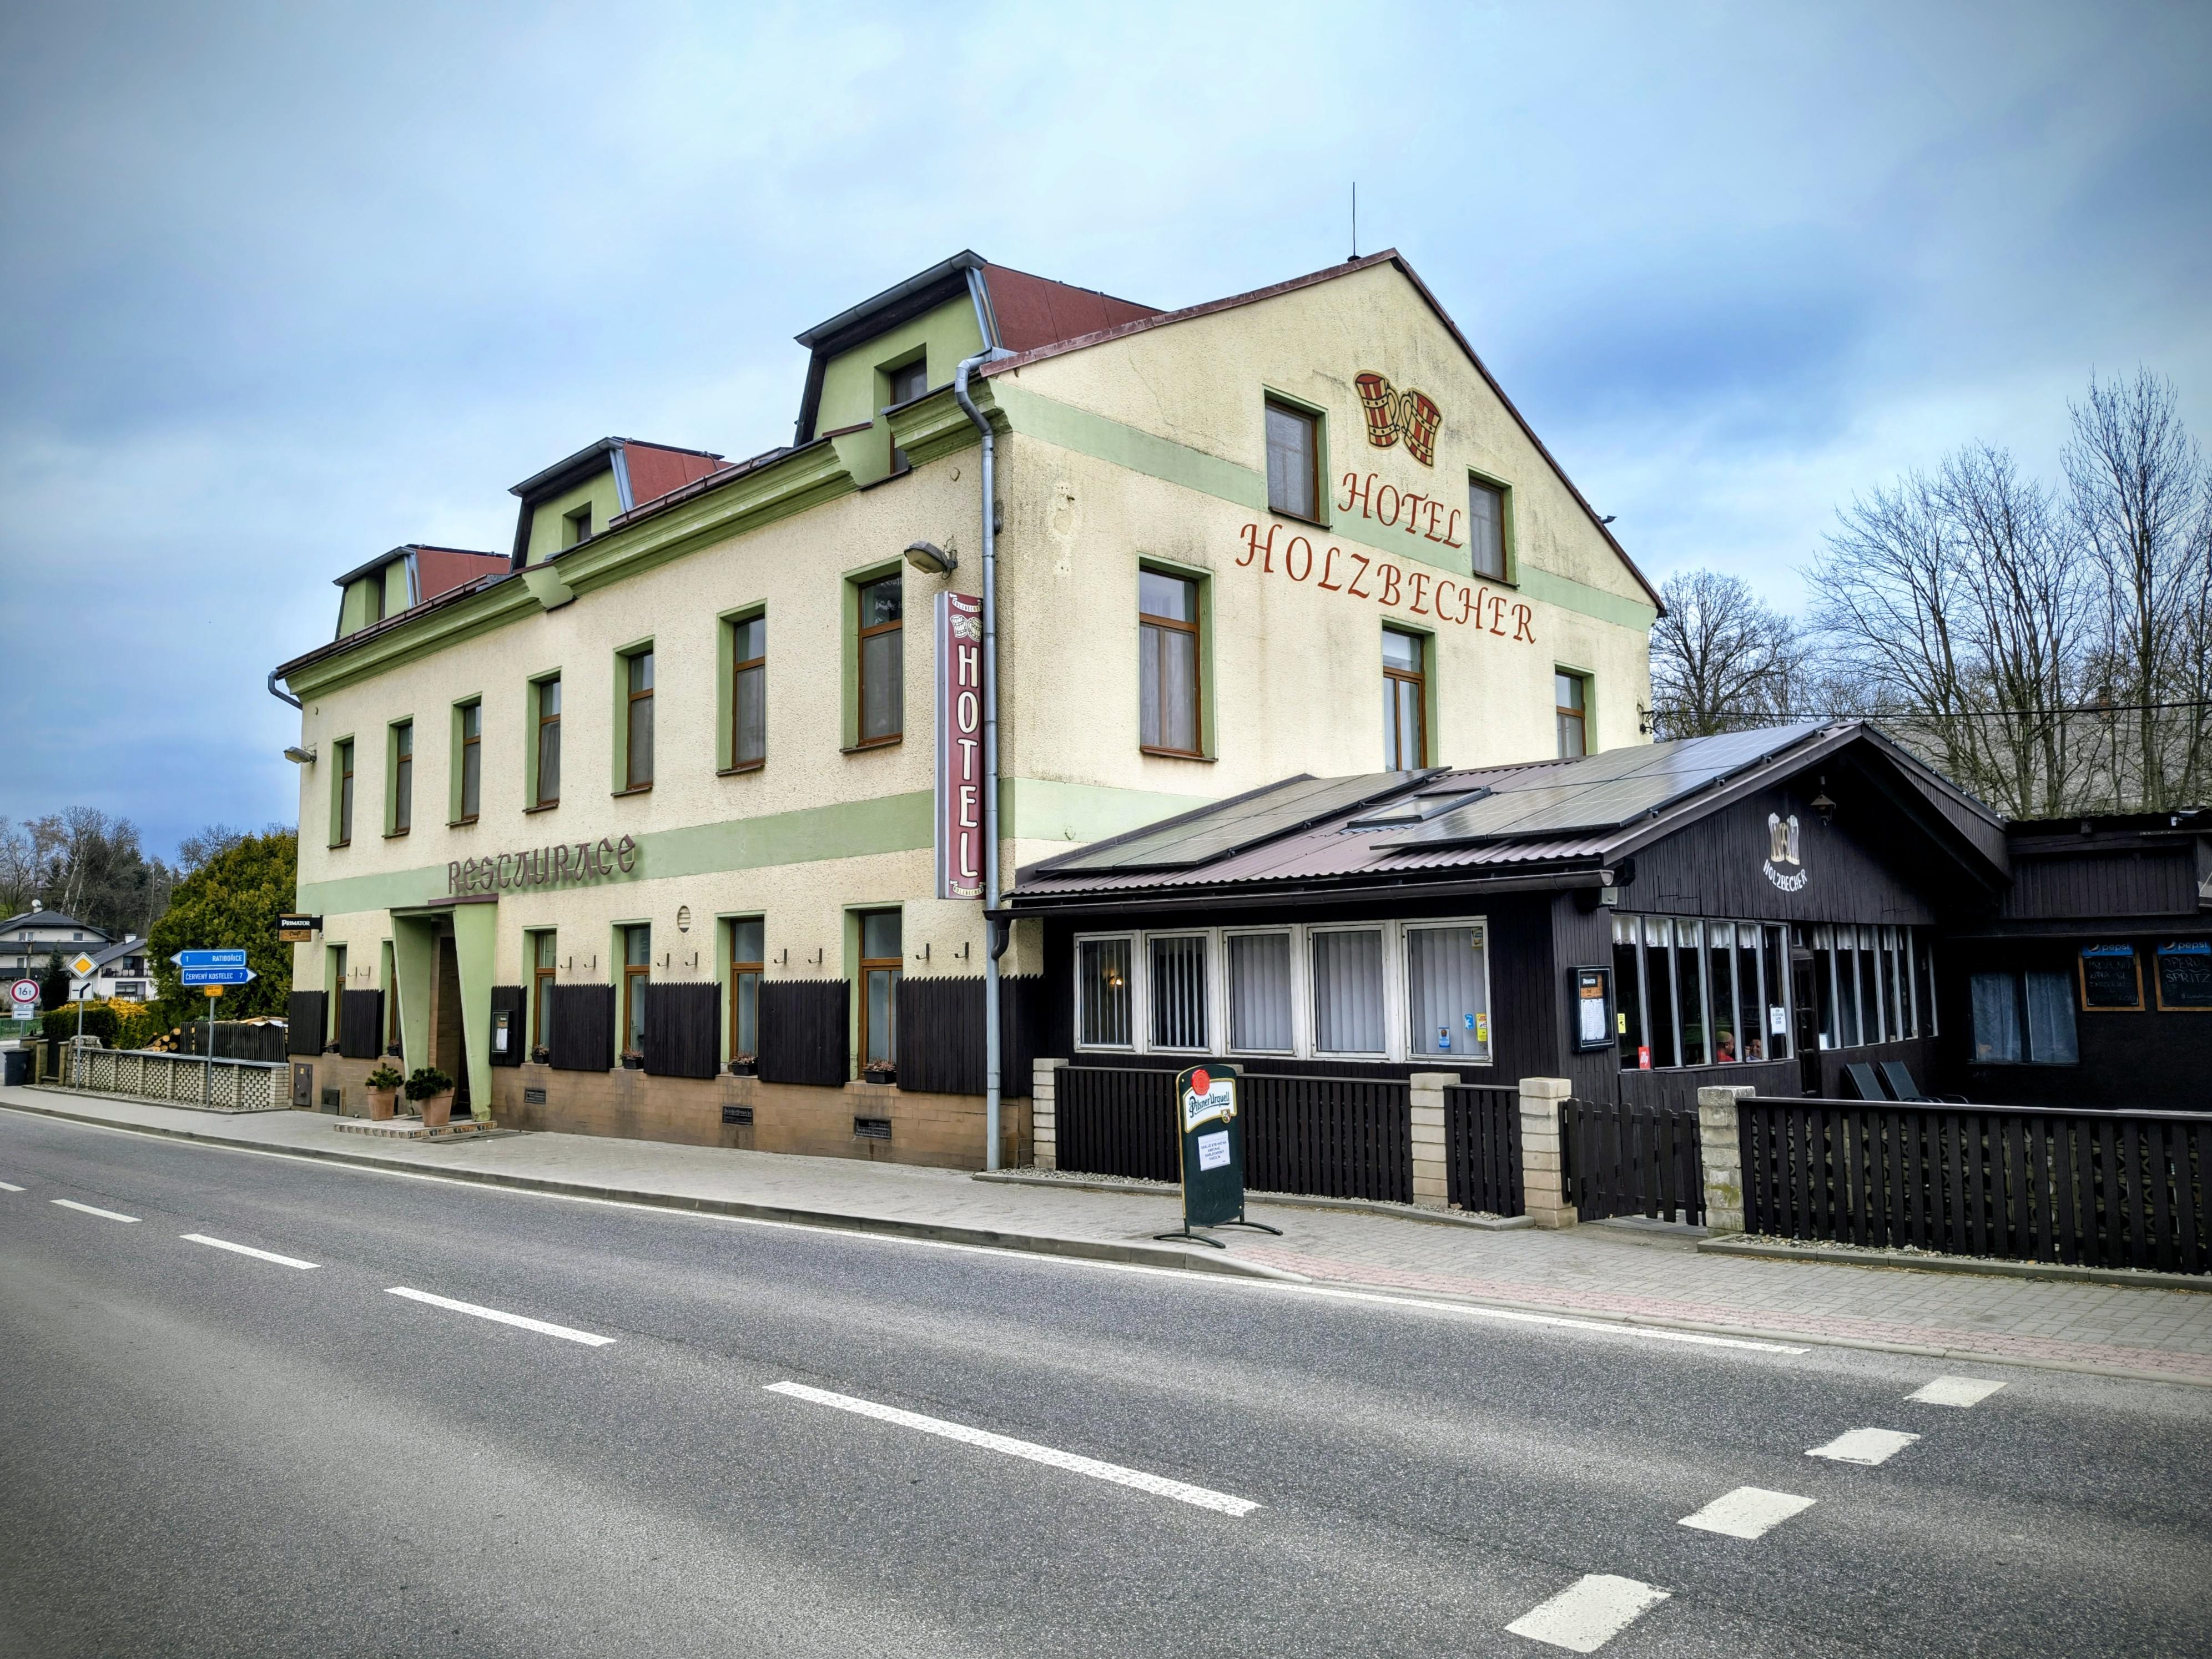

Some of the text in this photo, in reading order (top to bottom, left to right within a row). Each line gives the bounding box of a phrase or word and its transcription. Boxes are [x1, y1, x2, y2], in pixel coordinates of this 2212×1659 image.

[1337, 472, 1463, 549] HOTEL
[1235, 523, 1536, 644] HOLZBECHER
[957, 644, 979, 878] HOTEL
[1763, 859, 1808, 892] HOLZBECHER
[2102, 944, 2130, 952] pepsi
[2178, 941, 2207, 951] pepsi
[2166, 972, 2212, 983] SPRITZ
[18, 987, 28, 996] 16
[1189, 1091, 1230, 1118] Pilsner Urquell
